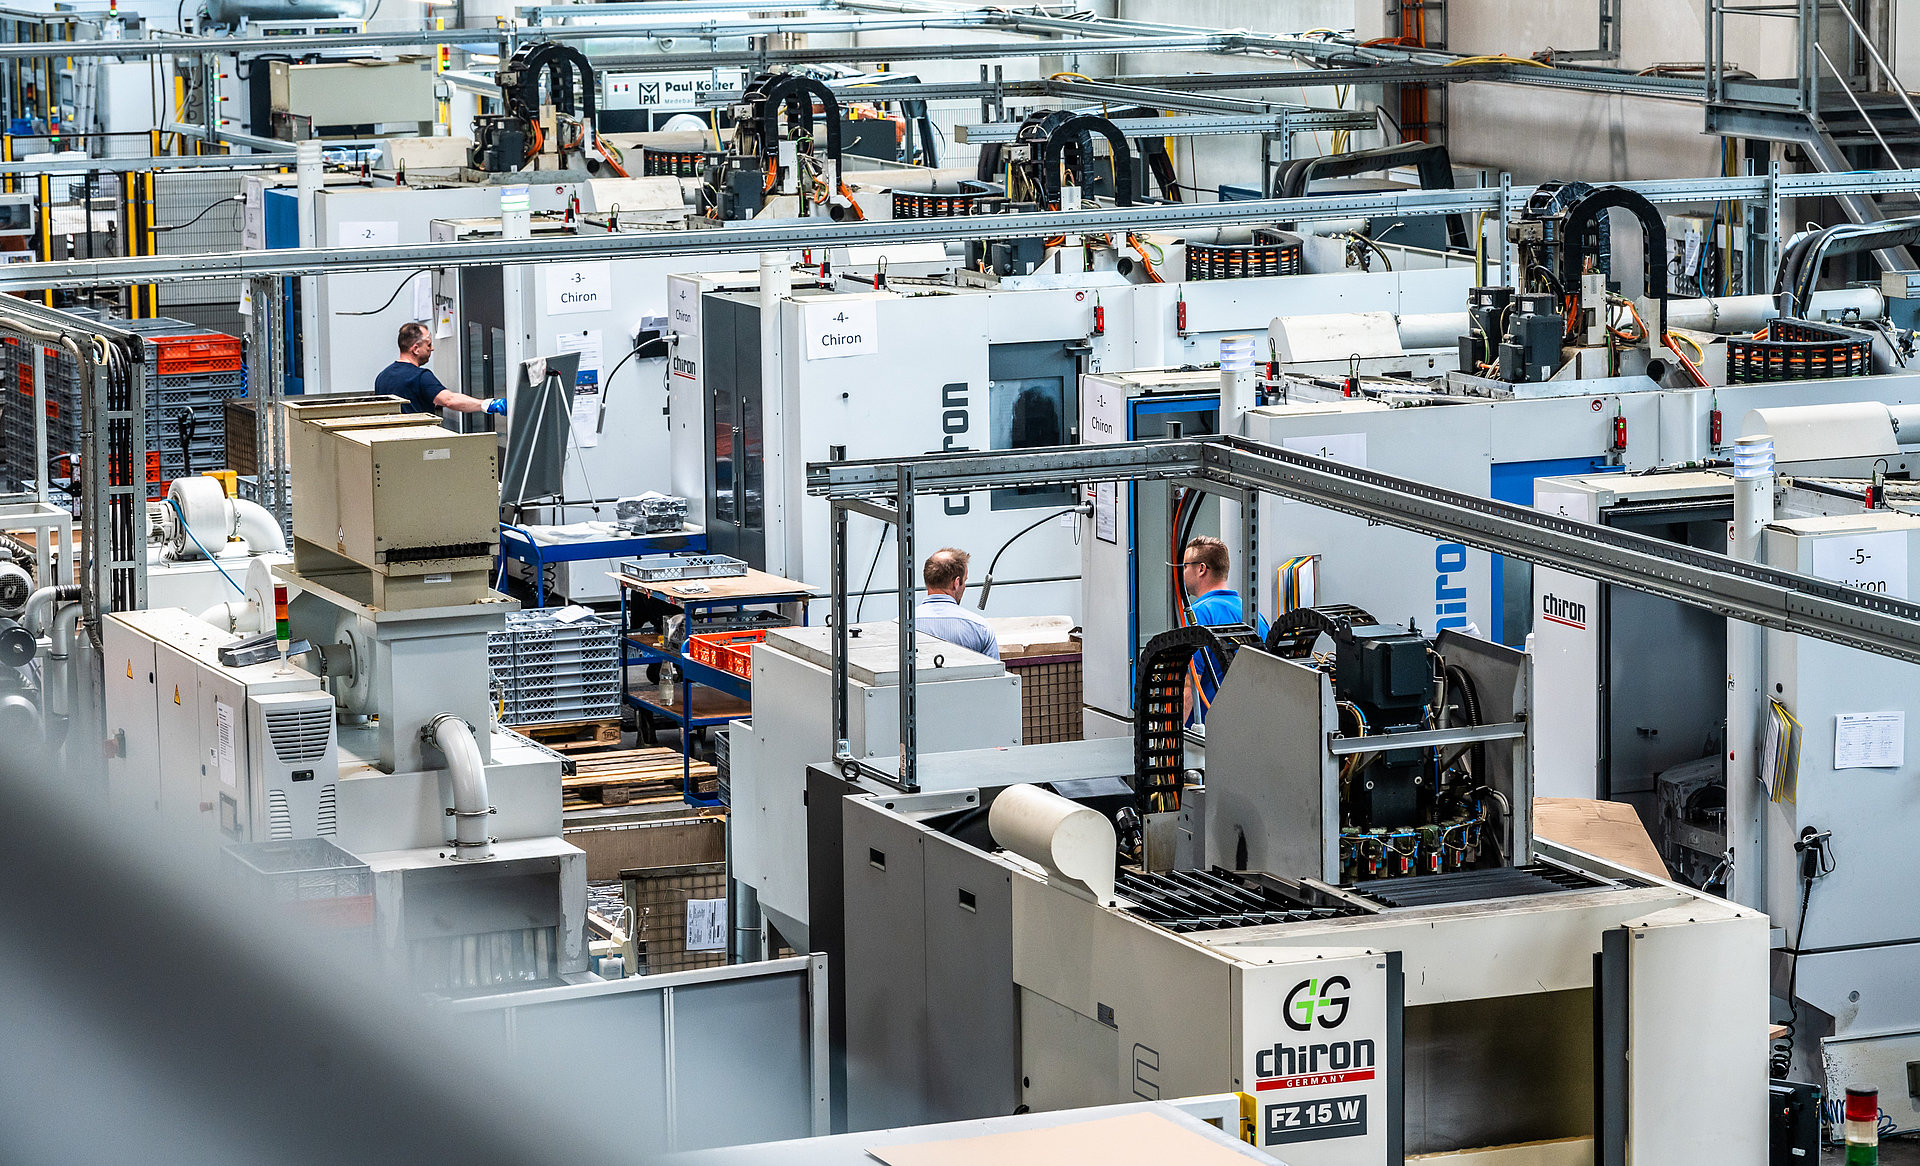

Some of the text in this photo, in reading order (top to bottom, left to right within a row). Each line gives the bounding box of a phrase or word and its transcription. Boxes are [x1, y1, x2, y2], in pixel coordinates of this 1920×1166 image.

[665, 80, 735, 92] Paul Köter
[361, 229, 376, 239] -2-
[570, 272, 586, 283] -3-
[560, 291, 598, 303] Chiron
[675, 309, 692, 323] Chiron
[832, 311, 850, 323] -4-
[821, 332, 862, 347] Chiron
[673, 355, 696, 375] chiron
[1096, 394, 1107, 408] -1-
[1091, 415, 1114, 435] Chiron
[1849, 548, 1872, 565] -5-
[1543, 592, 1587, 623] chiron
[1256, 1039, 1375, 1078] chiron
[1286, 1074, 1345, 1088] GERMANY
[1271, 1100, 1361, 1129] FZ 15 W
